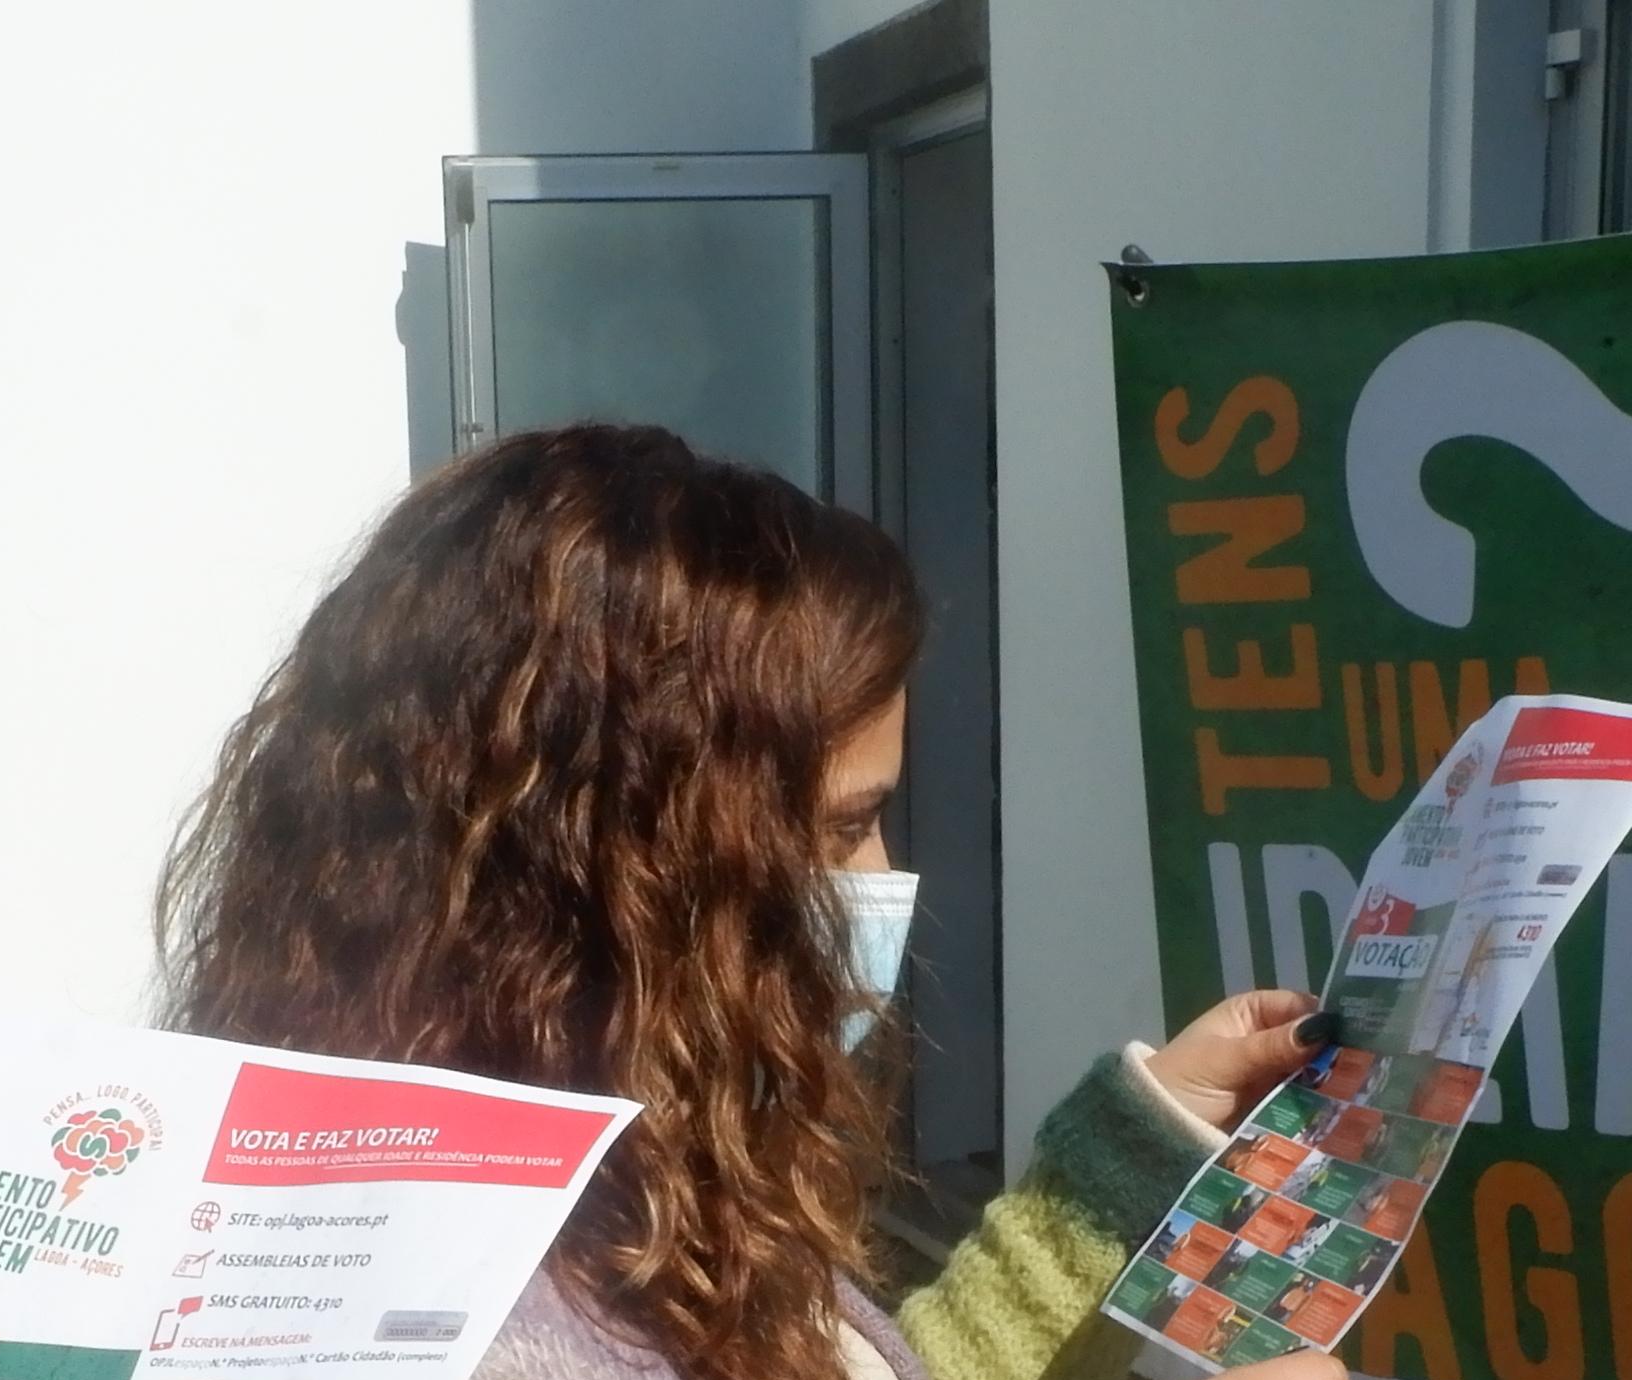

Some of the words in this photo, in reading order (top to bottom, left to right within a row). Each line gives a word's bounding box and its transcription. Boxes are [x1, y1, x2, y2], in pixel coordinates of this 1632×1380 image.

[1154, 373, 1332, 816] TENS
[1342, 657, 1552, 802] UM
[1553, 742, 1596, 756] VOTAR!
[1379, 900, 1395, 936] 3
[229, 1128, 289, 1150] VOTA
[294, 1132, 310, 1150] E
[311, 1130, 351, 1150] FAZ
[355, 1128, 441, 1147] VOTAR!
[485, 1153, 525, 1165] PODEM
[526, 1157, 563, 1167] VOTAR
[228, 1213, 263, 1227] SITE:
[264, 1213, 389, 1231] opj.lagoa-acores.pt
[80, 1258, 125, 1279] AÇORES
[216, 1253, 309, 1268] ASSEMBLEIAS
[311, 1254, 331, 1267] DE
[332, 1254, 371, 1267] VOTO
[207, 1294, 238, 1309] SMS
[240, 1295, 312, 1310] GRATUITO:
[313, 1297, 344, 1312] 4310
[181, 1337, 229, 1349] ESCREVE
[230, 1337, 246, 1348] NA
[246, 1334, 312, 1348] MENSAGEM:
[315, 1351, 350, 1363] Cartão
[352, 1350, 396, 1362] Cidadão
[397, 1352, 448, 1363] (completo)
